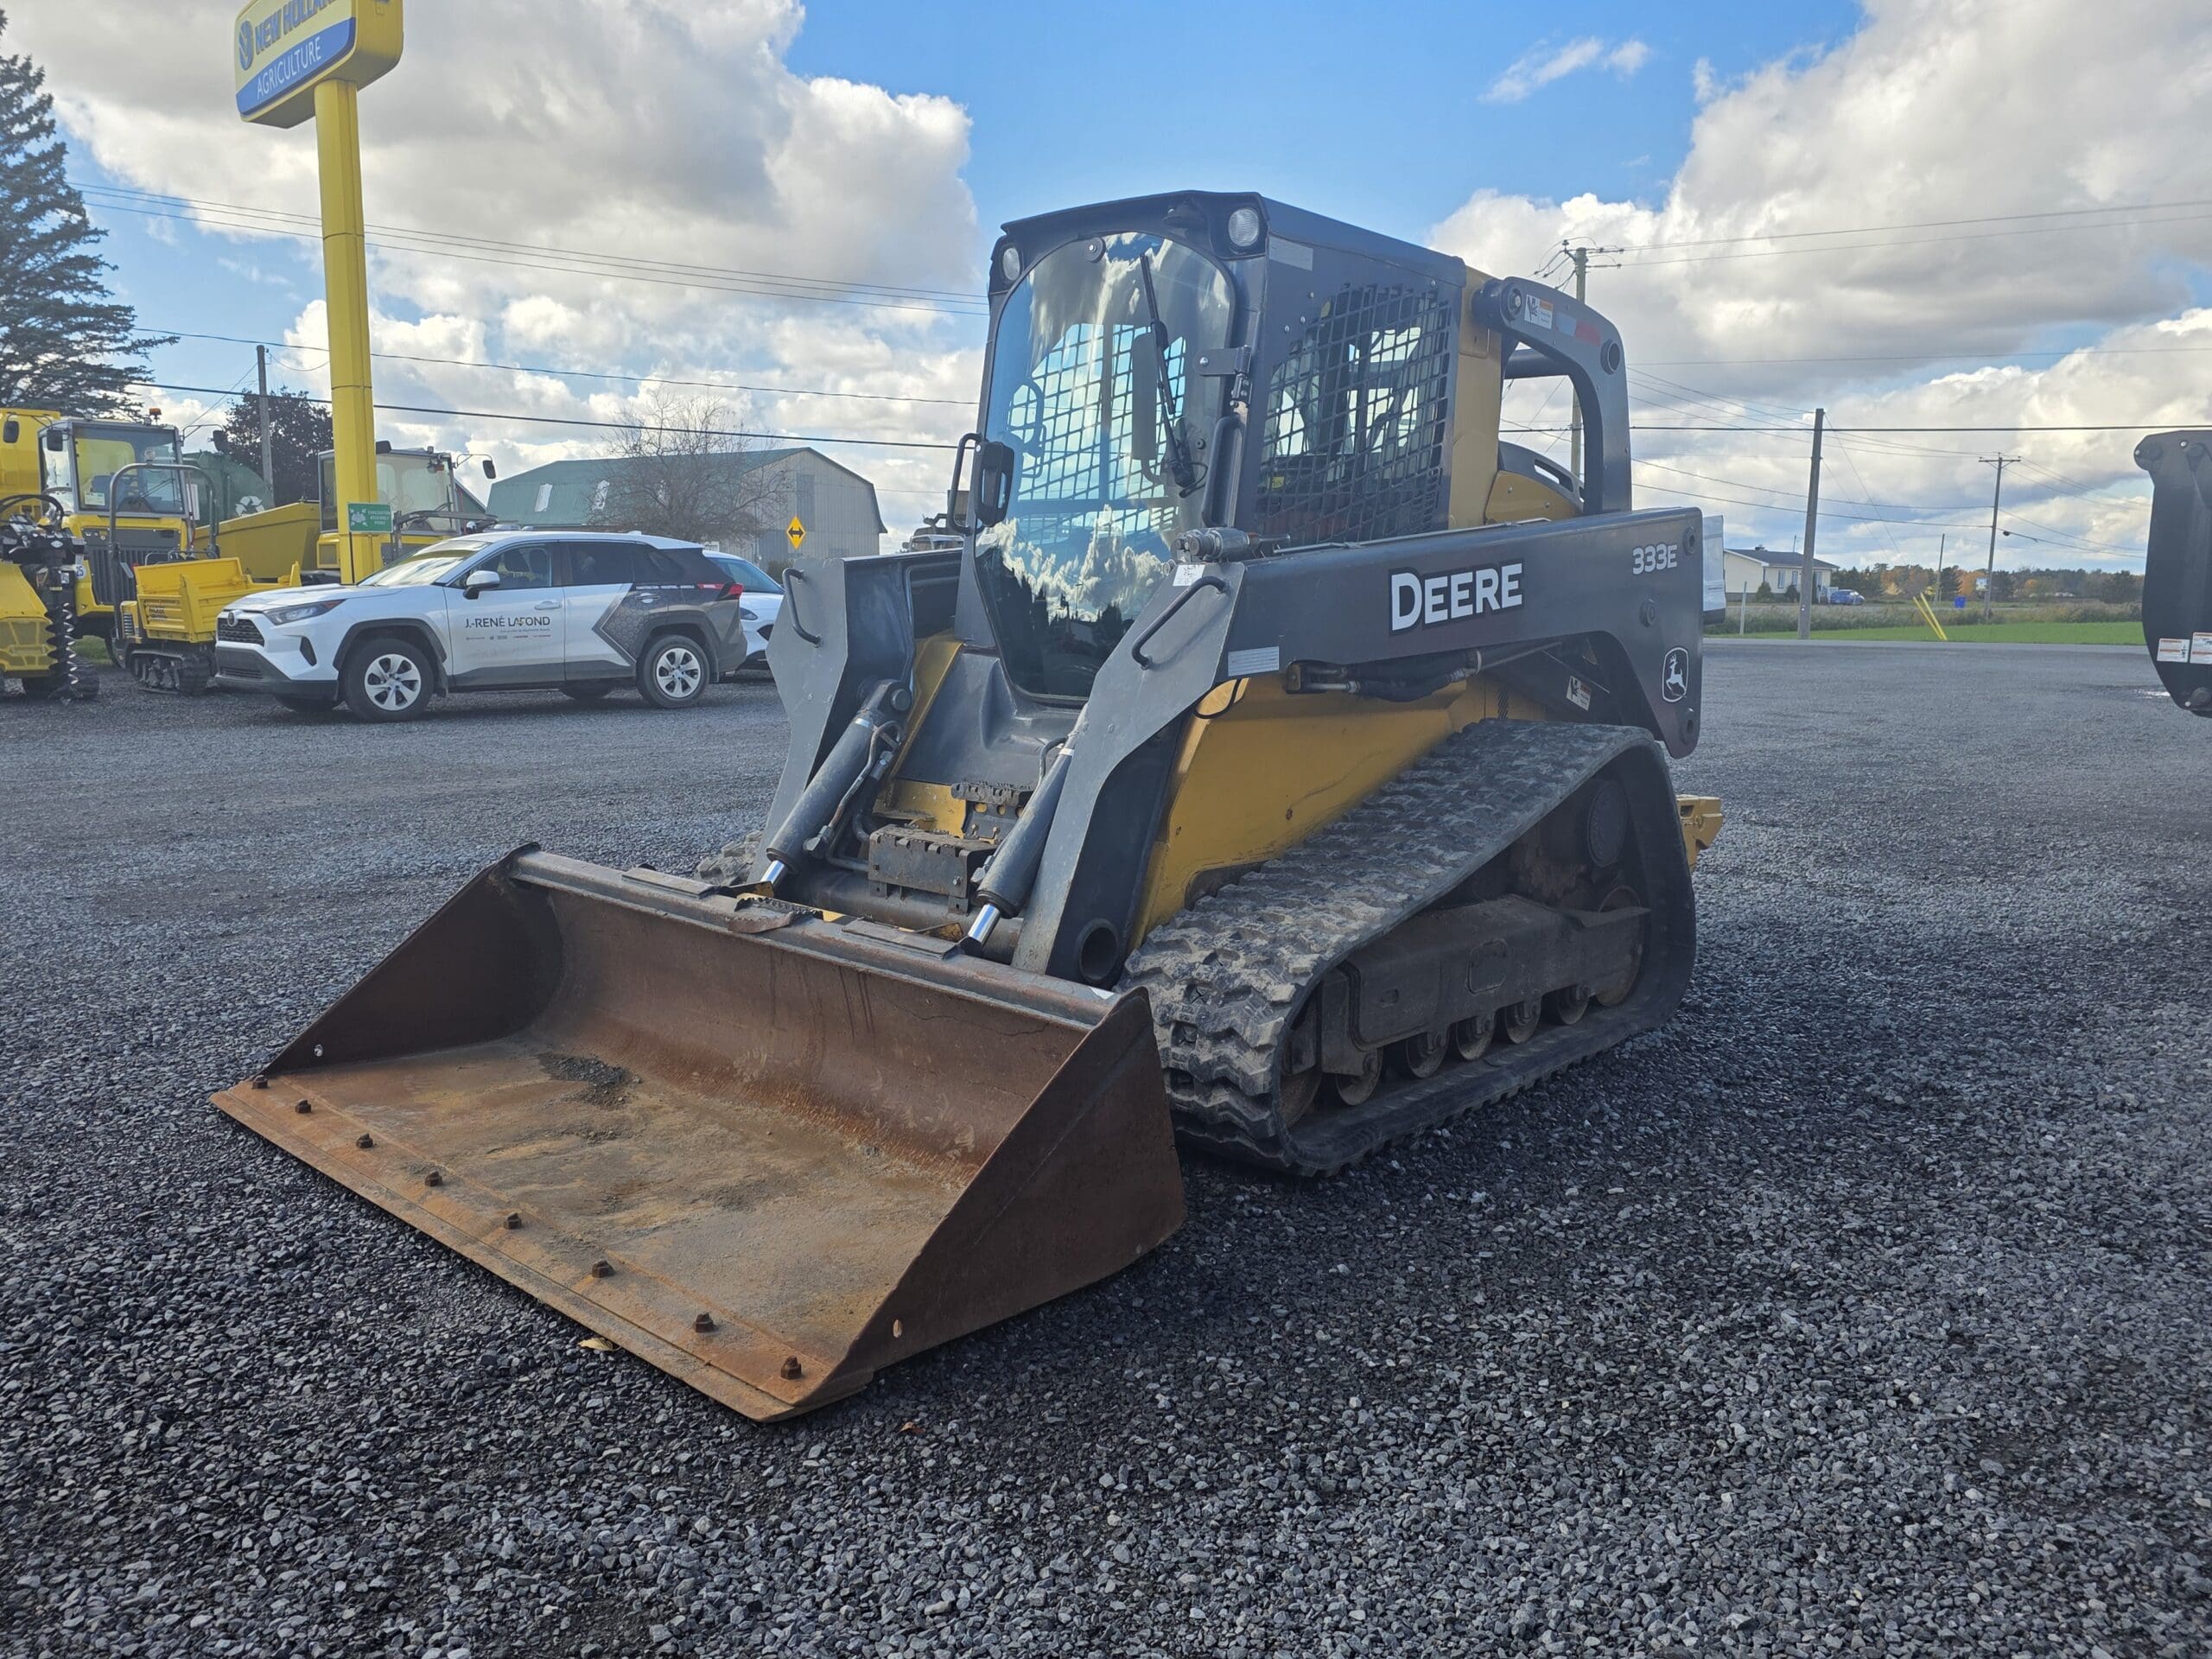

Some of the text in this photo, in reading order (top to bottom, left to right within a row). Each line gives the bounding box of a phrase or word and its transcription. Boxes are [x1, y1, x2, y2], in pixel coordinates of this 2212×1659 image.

[254, 8, 282, 55] NEW
[257, 36, 321, 100] AGRICULTURE
[1632, 543, 1678, 575] 333E
[1391, 563, 1522, 631] DEERE
[508, 616, 550, 626] LAFOND
